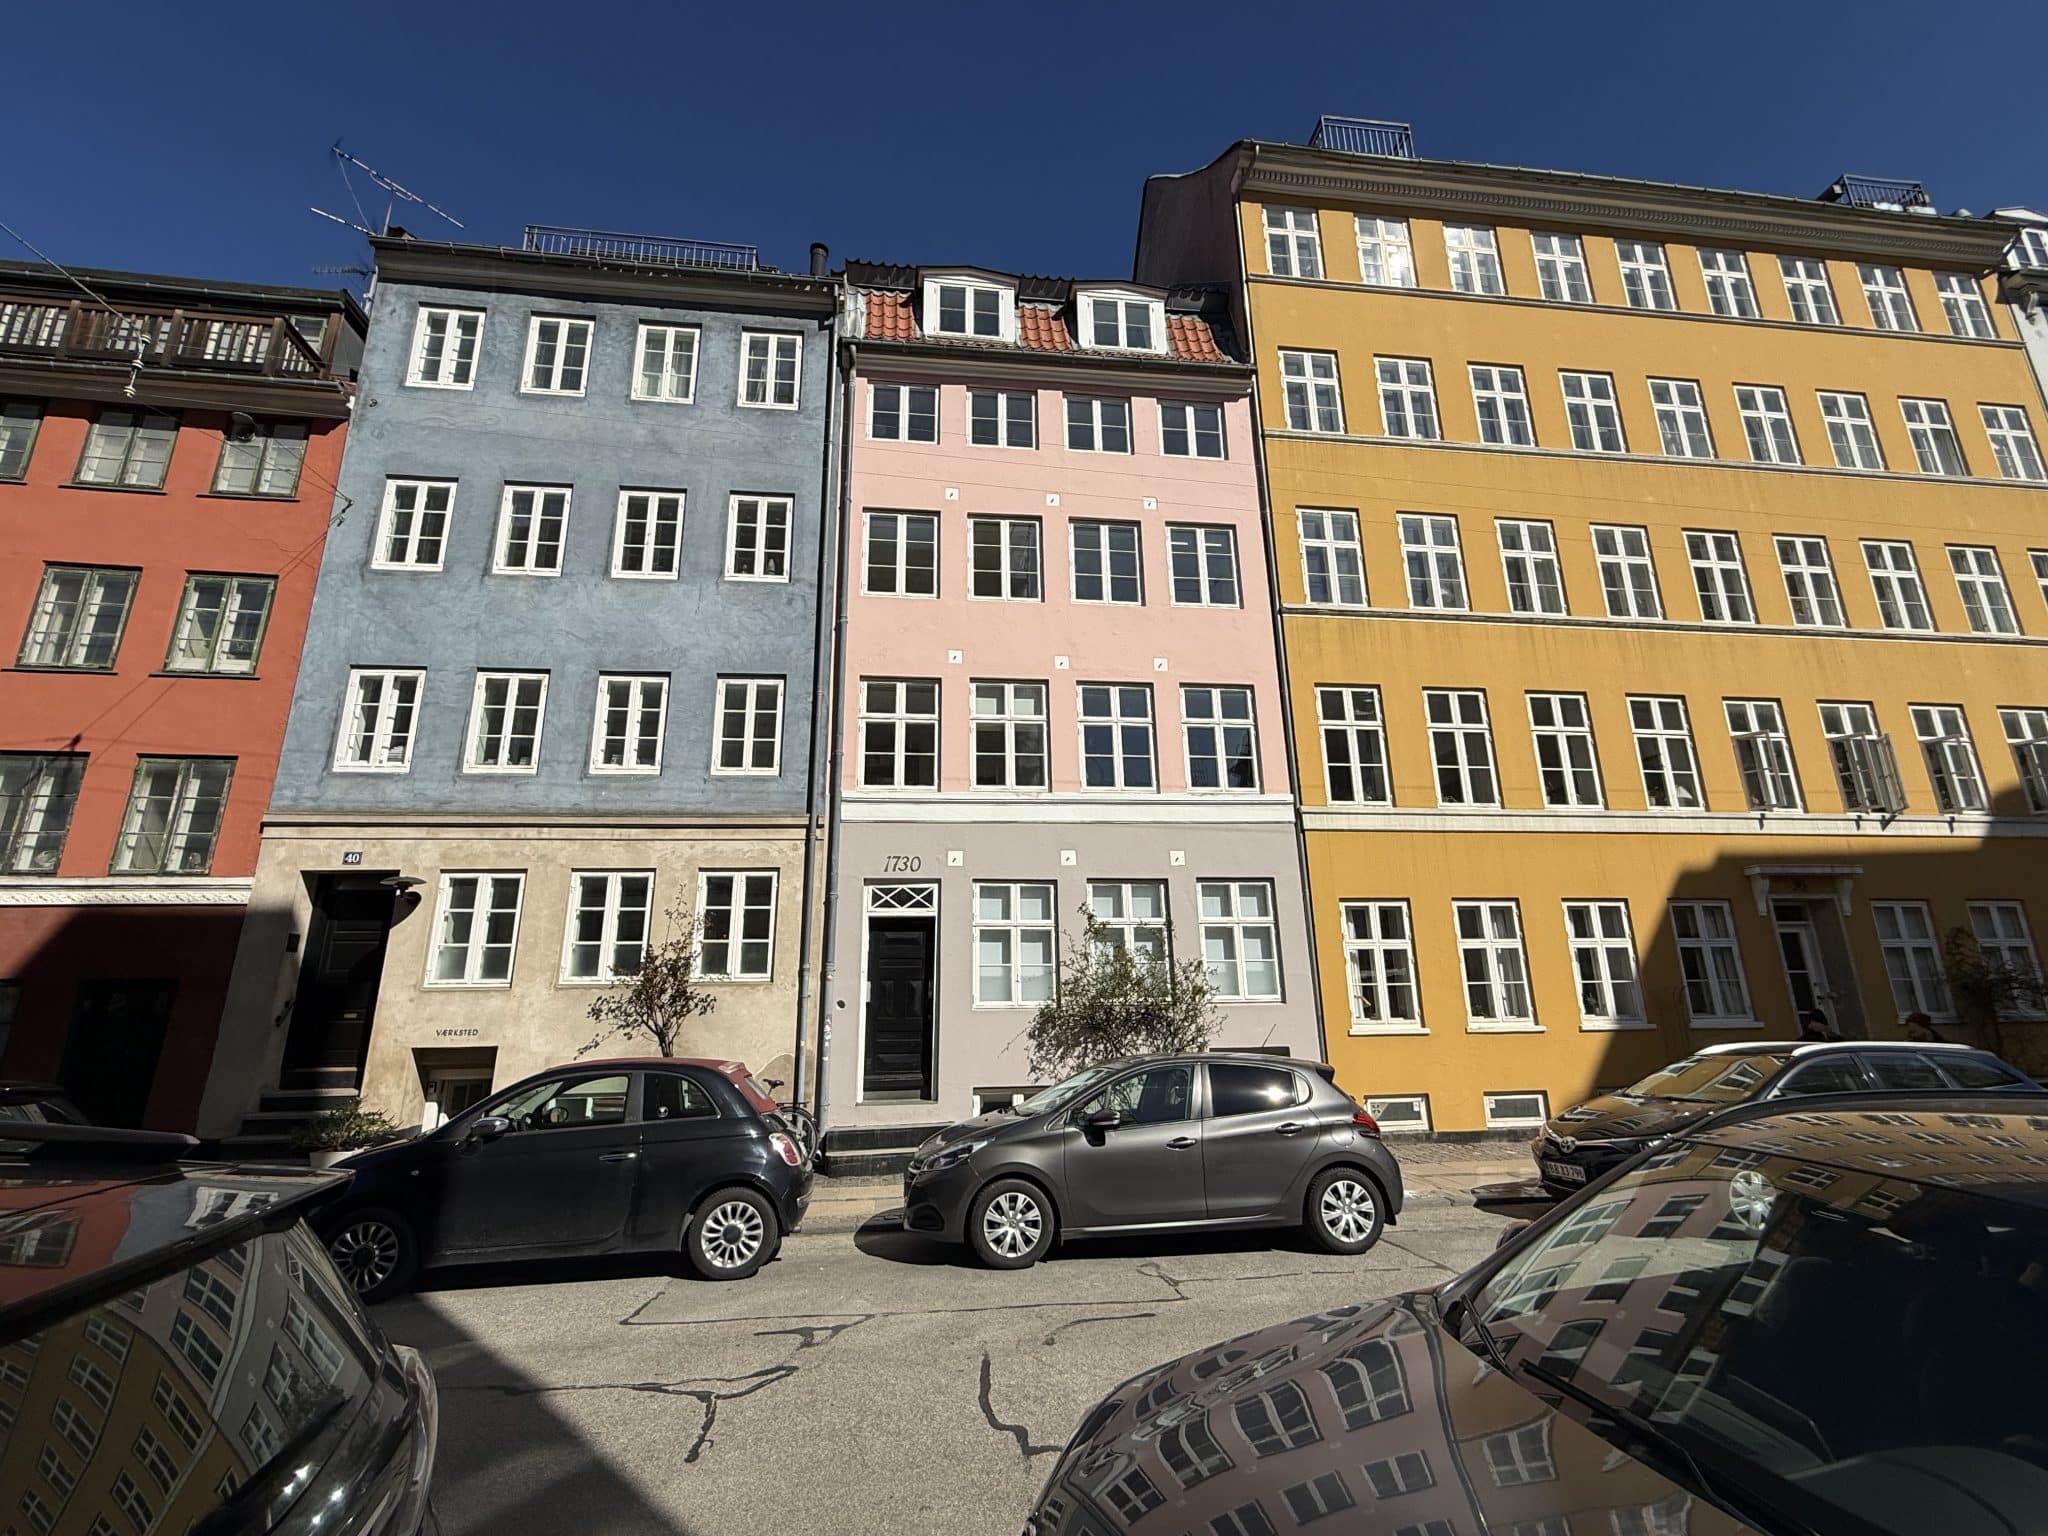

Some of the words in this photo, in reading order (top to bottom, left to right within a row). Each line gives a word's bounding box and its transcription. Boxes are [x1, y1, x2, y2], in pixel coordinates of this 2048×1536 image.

[345, 853, 360, 863] 40
[883, 855, 922, 872] 1730
[435, 1028, 479, 1037] VÆRKSTED
